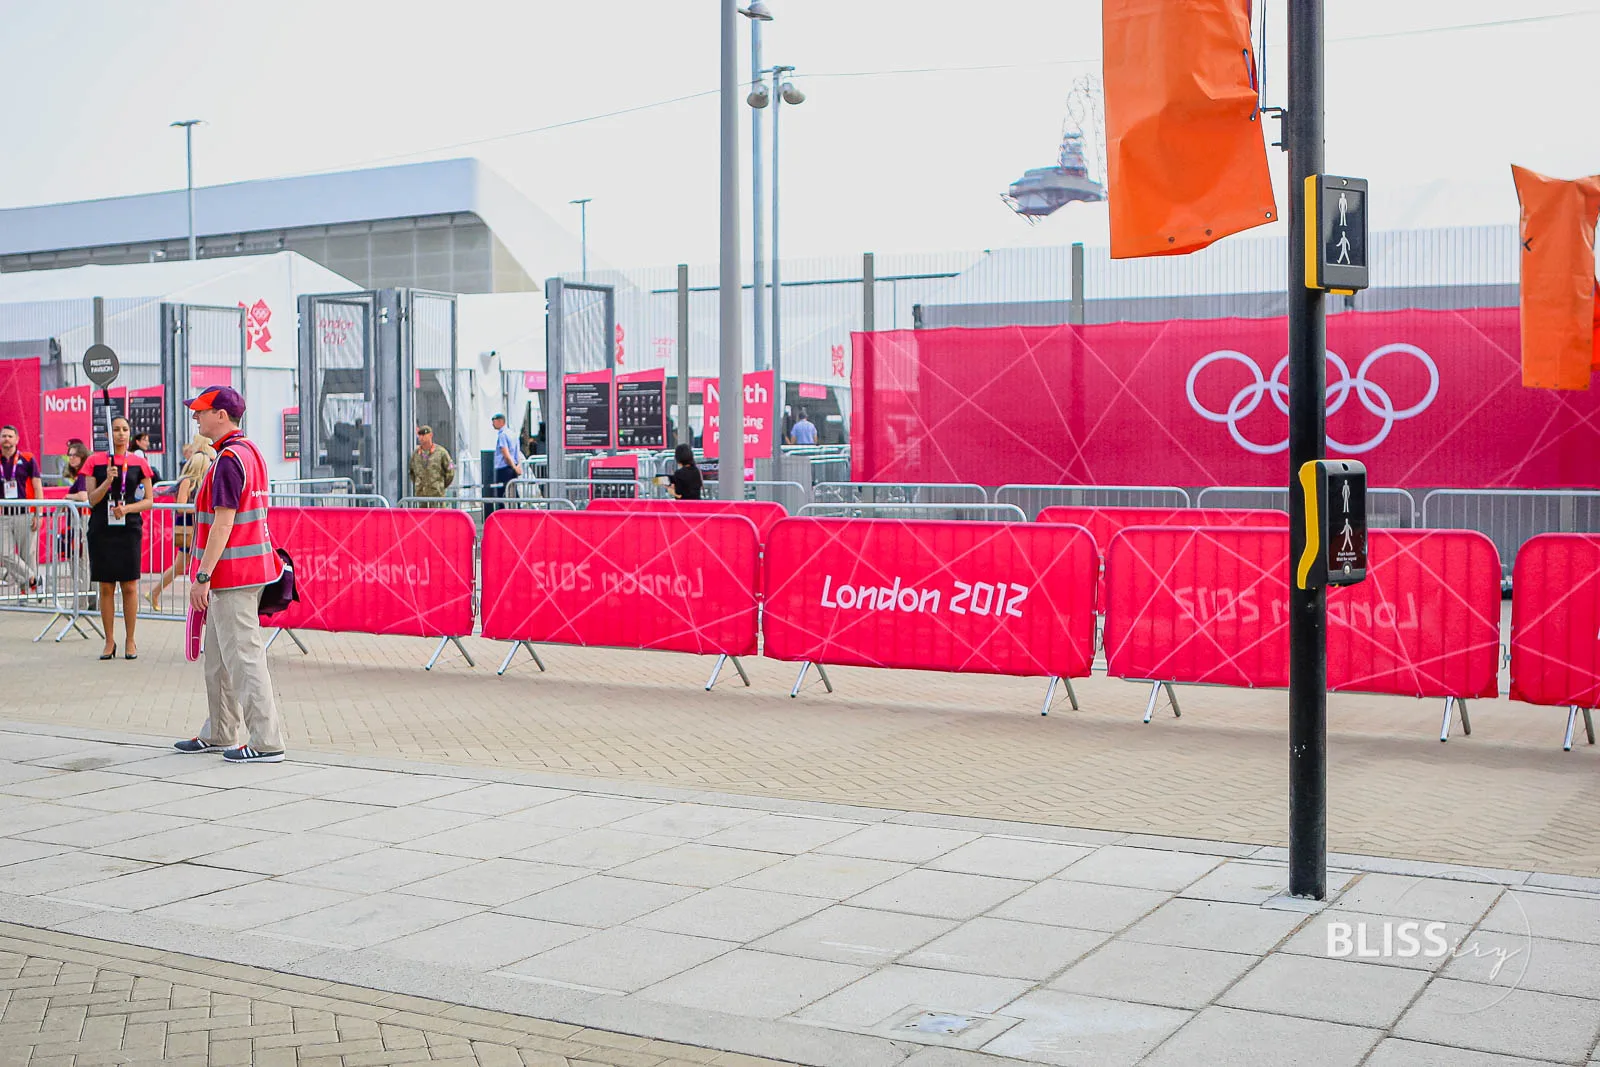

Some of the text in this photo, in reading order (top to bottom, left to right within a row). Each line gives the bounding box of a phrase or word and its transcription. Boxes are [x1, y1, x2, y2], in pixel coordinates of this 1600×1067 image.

[45, 395, 87, 412] North
[707, 383, 768, 404] Nth
[821, 575, 1028, 617] London 2012
